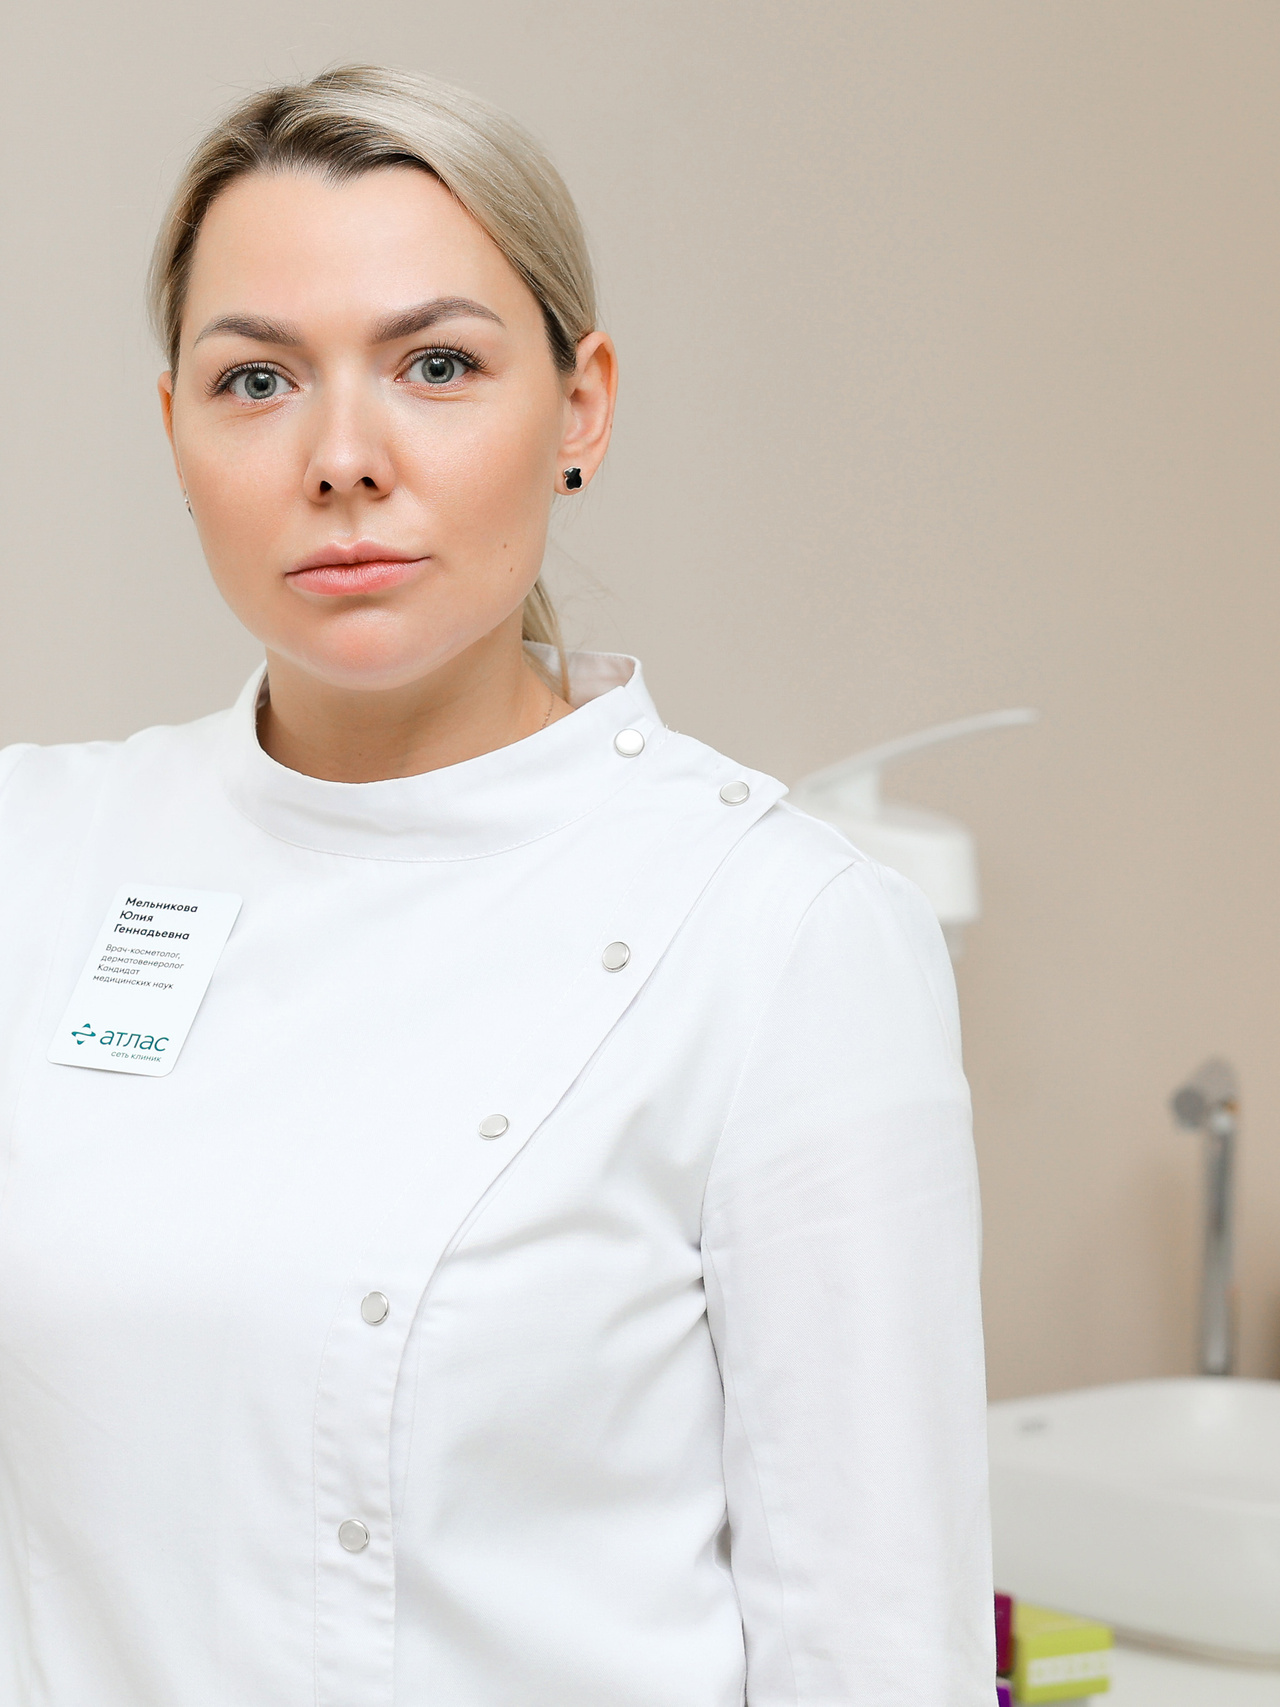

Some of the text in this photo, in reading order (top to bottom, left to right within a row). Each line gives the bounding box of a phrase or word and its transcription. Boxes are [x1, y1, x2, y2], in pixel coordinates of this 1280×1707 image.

[125, 897, 198, 912] Мельникова
[119, 911, 153, 922] Юлия
[114, 924, 190, 940] Геннадьевна
[105, 943, 181, 960] Врач-косметолог,
[96, 963, 141, 976] Кандидат
[100, 954, 185, 970] дерматовенеролог
[92, 974, 174, 990] медицинских наук
[99, 1030, 170, 1052] атлас
[111, 1051, 162, 1062] сеть клиник
